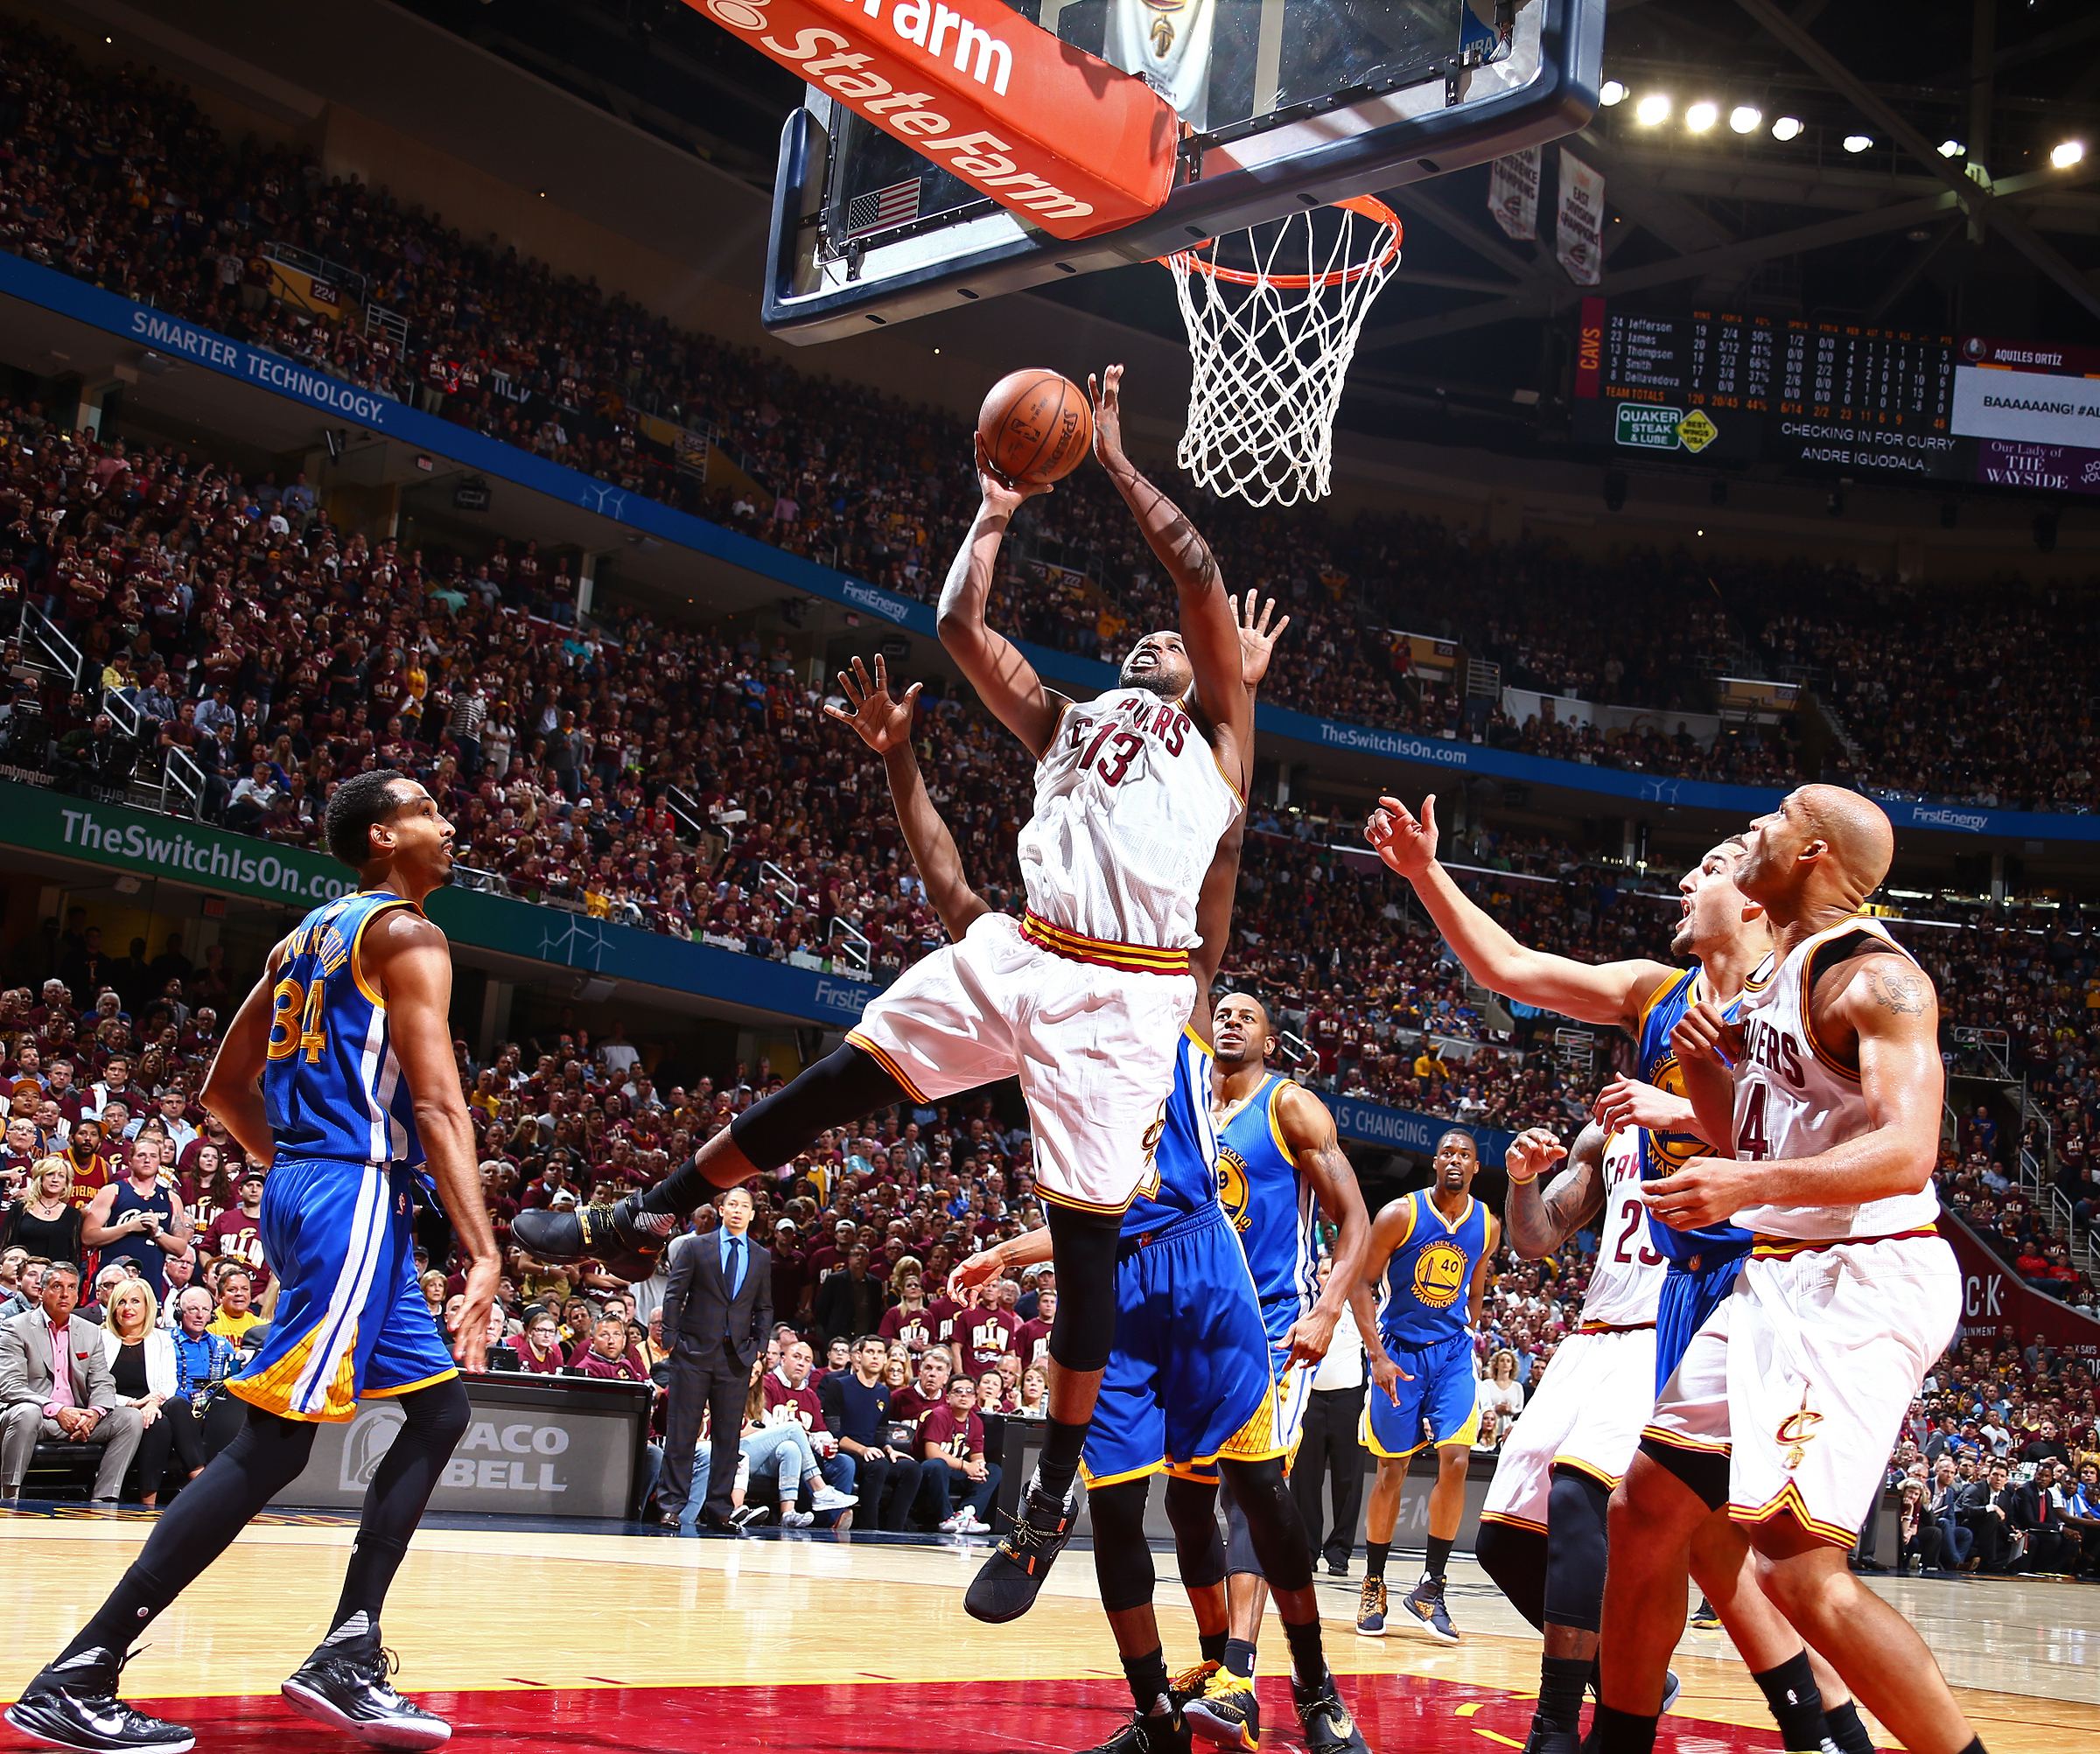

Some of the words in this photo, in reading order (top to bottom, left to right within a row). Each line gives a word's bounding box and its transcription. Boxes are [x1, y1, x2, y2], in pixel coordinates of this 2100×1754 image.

[863, 0, 1013, 96] arm
[312, 283, 337, 303] 224
[1612, 316, 1624, 328] 24
[1628, 318, 1673, 332] Jefferson
[1696, 325, 1707, 336] 19
[1722, 327, 1739, 339] 2/4
[1751, 331, 1773, 343] 50%
[1789, 334, 1804, 346] 1/2
[1818, 337, 1835, 350] 0/0
[1579, 327, 1601, 370] CAVS
[1610, 330, 1622, 341] 23
[1627, 332, 1656, 346] James
[1693, 338, 1706, 350] 20
[1718, 341, 1740, 353] 5/12
[1750, 345, 1772, 357] 41%
[1787, 347, 1803, 360] 0/0
[1817, 351, 1834, 363] 0/0
[1883, 357, 1891, 369] 2
[1939, 363, 1950, 375] 10
[1994, 348, 2034, 363] AQUILES
[132, 311, 238, 368] SMARTER
[247, 353, 384, 423] TECHNOLOGY.
[1610, 342, 1621, 354] 13
[1627, 345, 1674, 360] Thompson
[1693, 352, 1704, 363] 18
[1719, 354, 1736, 367] 2/3
[1749, 357, 1770, 370] 66%
[1786, 360, 1802, 373] 0/0
[1816, 364, 1833, 376] 2/2
[1914, 374, 1925, 386] 10
[1624, 371, 1680, 387] Dellavedova
[1718, 380, 1734, 393] 0/0
[1749, 383, 1766, 396] 0%
[1784, 386, 1801, 399] 0/0
[1814, 389, 1830, 402] 0/0
[1912, 400, 1922, 412] -8
[1625, 358, 1652, 371] Smith
[1692, 365, 1704, 376] 17
[1718, 367, 1735, 380] 3/8
[1748, 370, 1770, 383] 37%
[1785, 374, 1802, 386] 2/6
[1816, 376, 1832, 389] 0/0
[1913, 387, 1924, 399] 15
[1606, 386, 1630, 398] TEAM
[1632, 388, 1665, 402] TOTALS
[1688, 393, 1704, 404] 120
[1712, 395, 1739, 409] 20/45
[1746, 399, 1768, 411] 44%
[1781, 402, 1802, 414] 6/14
[1813, 406, 1830, 417] 2/2
[1840, 409, 1852, 420] 23
[1861, 410, 1871, 422] 11
[1895, 414, 1902, 425] 9
[1620, 409, 1679, 423] QUAKER
[1630, 434, 1638, 443] &
[1640, 434, 1669, 444] LUBE
[1631, 423, 1672, 435] STEAK
[1782, 422, 1855, 441] CHECKING
[1858, 430, 1872, 443] IN
[1874, 432, 1903, 446] FOR
[1907, 435, 1956, 451] CURRY
[1801, 447, 1851, 464] ANDRE
[1853, 451, 1925, 471] IGUODALA
[1991, 440, 2014, 452] Our
[2017, 444, 2048, 458] Lady
[2050, 447, 2064, 458] of
[2006, 454, 2046, 472] THE
[1985, 468, 2069, 489] WAYSIDE
[1063, 573, 1083, 589] 222
[843, 580, 909, 620] FirstEnergy
[1078, 722, 1144, 788] 13
[1320, 723, 1467, 764] TheSwitchIsOn.com
[0, 764, 54, 785] untington
[91, 785, 124, 800] CLUB
[128, 793, 166, 809] LEVE
[1912, 807, 1989, 829] FirstEnergy
[815, 980, 875, 1012] FirstE
[266, 977, 328, 1064] 34
[1648, 1049, 1677, 1078] GOLD
[1336, 1106, 1350, 1129] IS
[1355, 1111, 1432, 1148] CHANGING.
[1221, 1146, 1249, 1170] STATE
[1219, 1170, 1228, 1190] 9
[1419, 1240, 1451, 1254] GOLDEN
[1452, 1243, 1469, 1263] STATE
[1441, 1259, 1459, 1274] 40
[1410, 1283, 1460, 1309] WARRIORS
[2081, 1345, 2097, 1354] SAYS
[461, 1422, 570, 1456] ACO
[440, 1457, 568, 1492] BELL
